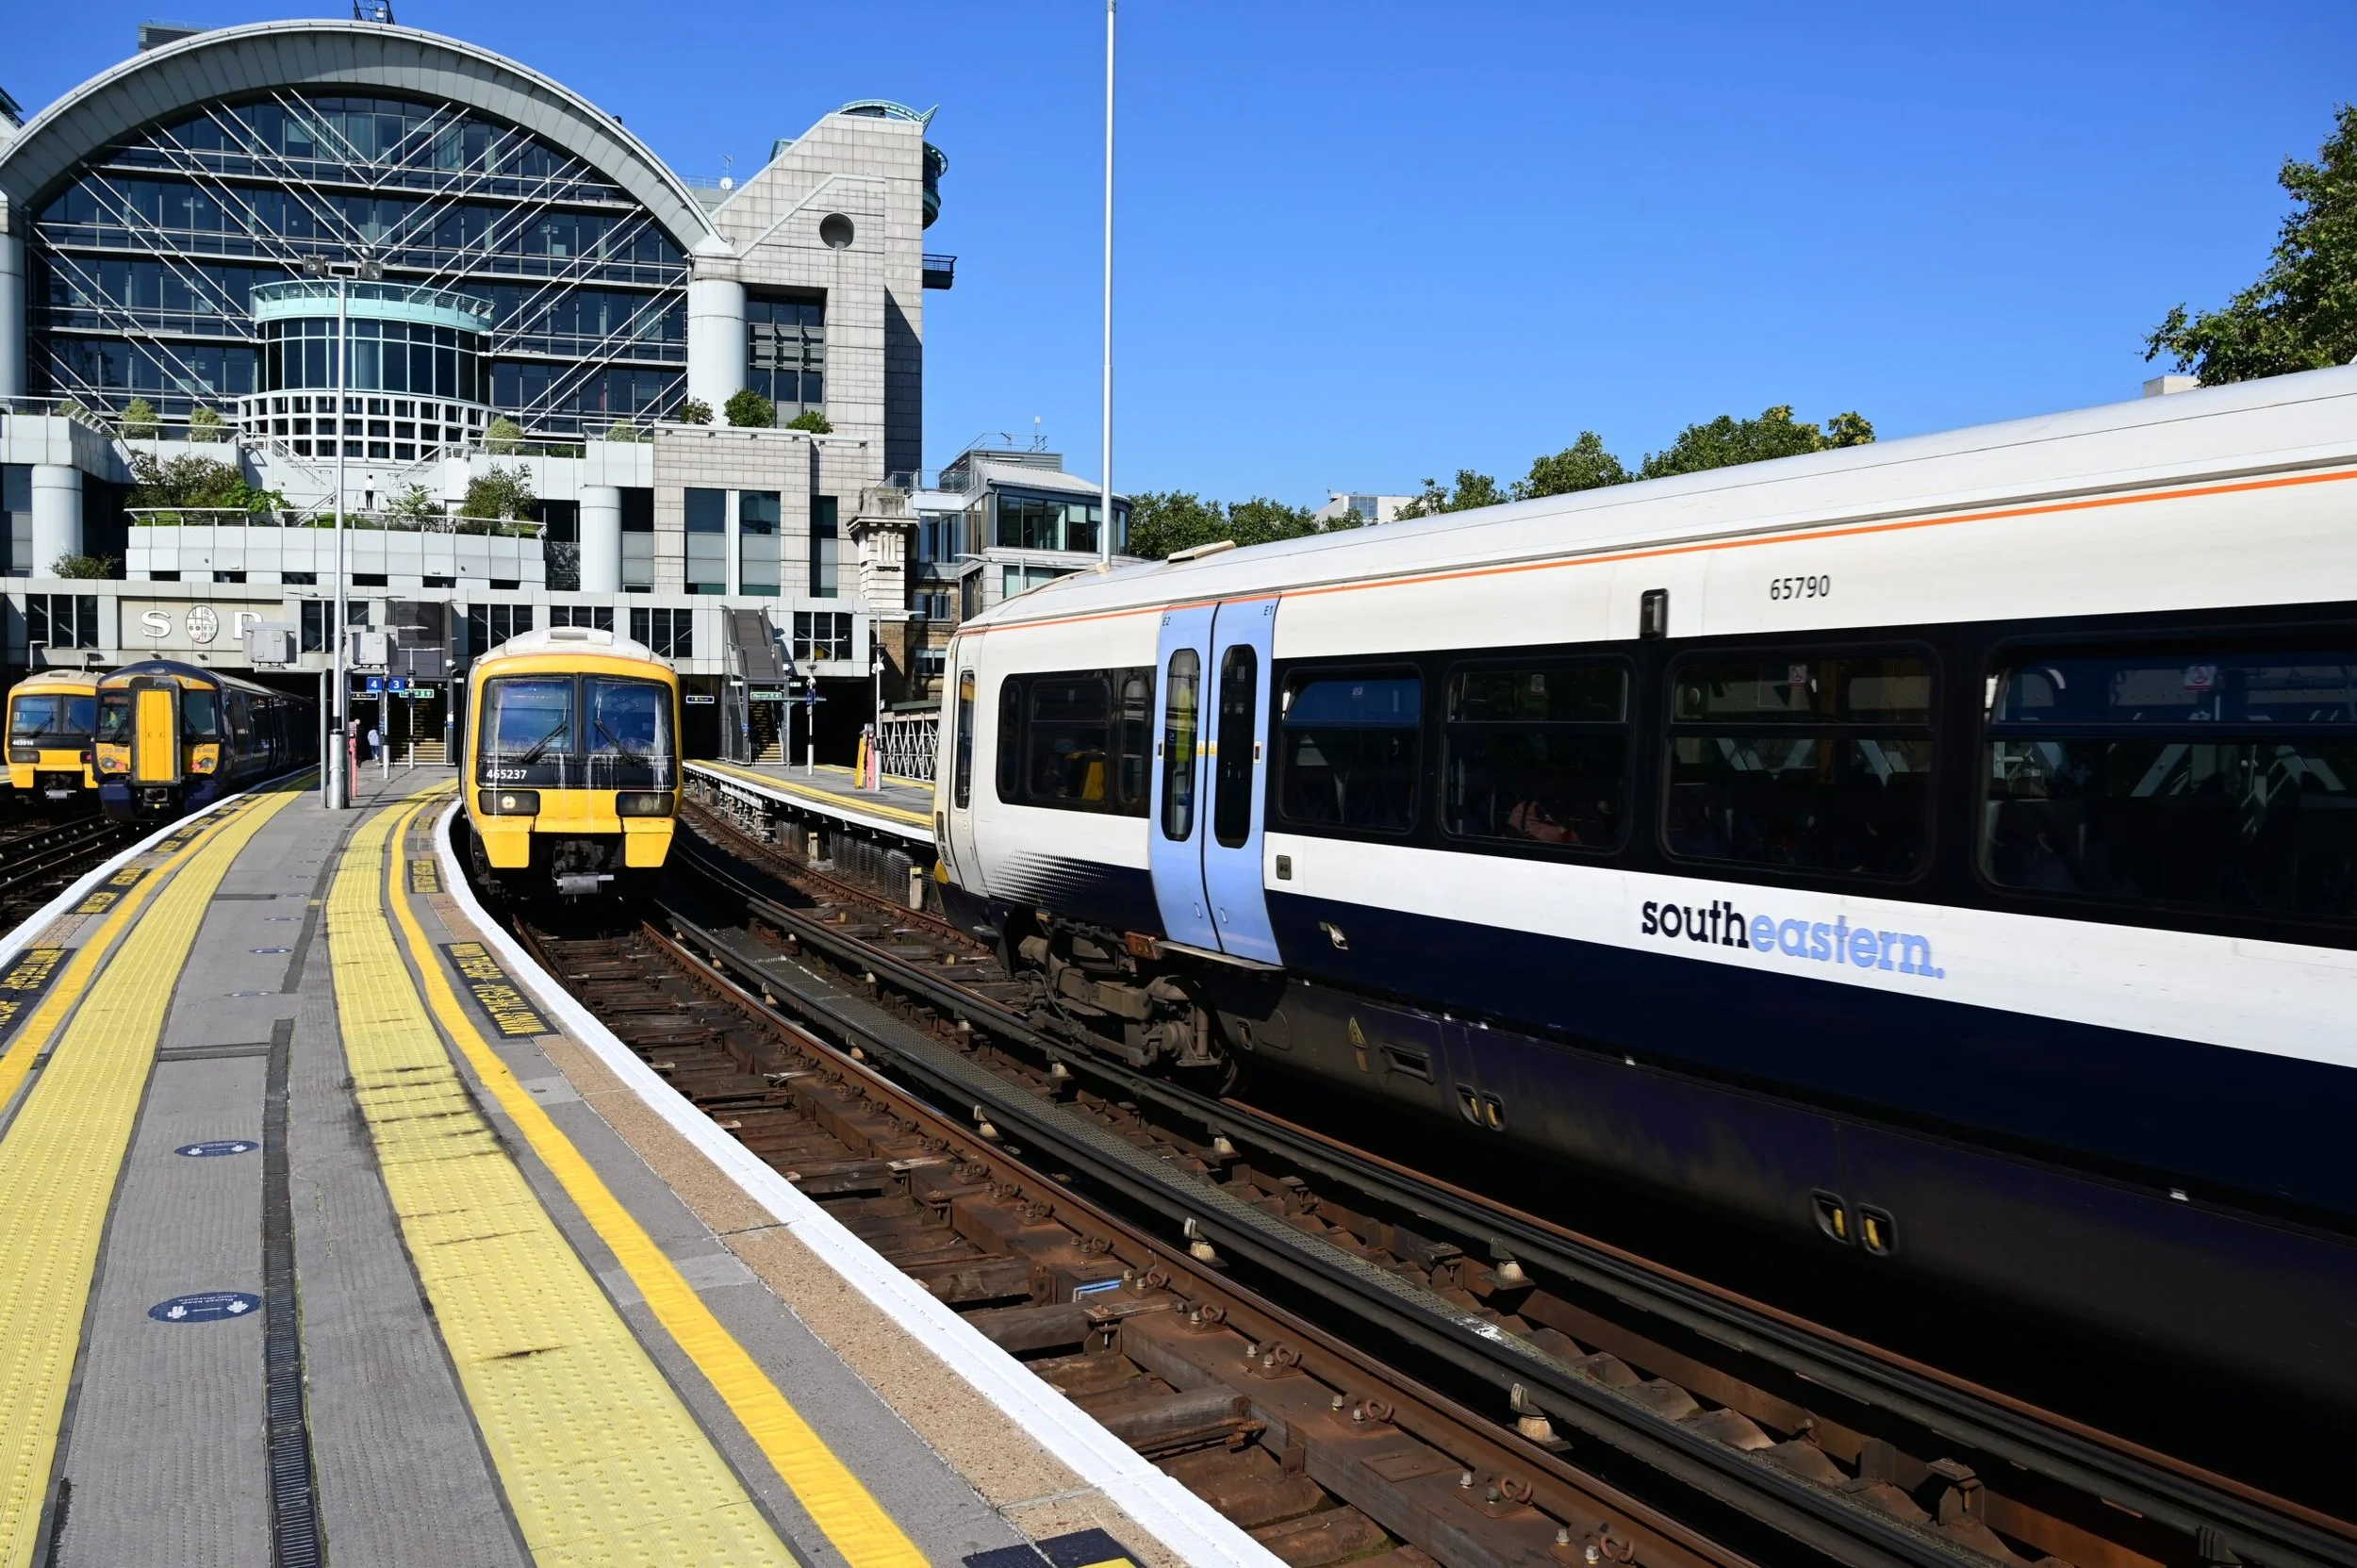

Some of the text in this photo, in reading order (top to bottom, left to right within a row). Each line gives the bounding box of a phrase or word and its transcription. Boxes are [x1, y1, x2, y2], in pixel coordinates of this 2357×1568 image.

[1771, 574, 1830, 601] 65790
[140, 609, 172, 638] S
[1162, 616, 1171, 626] E2
[370, 680, 378, 688] 4
[393, 680, 400, 689] 3
[486, 769, 527, 780] 465237
